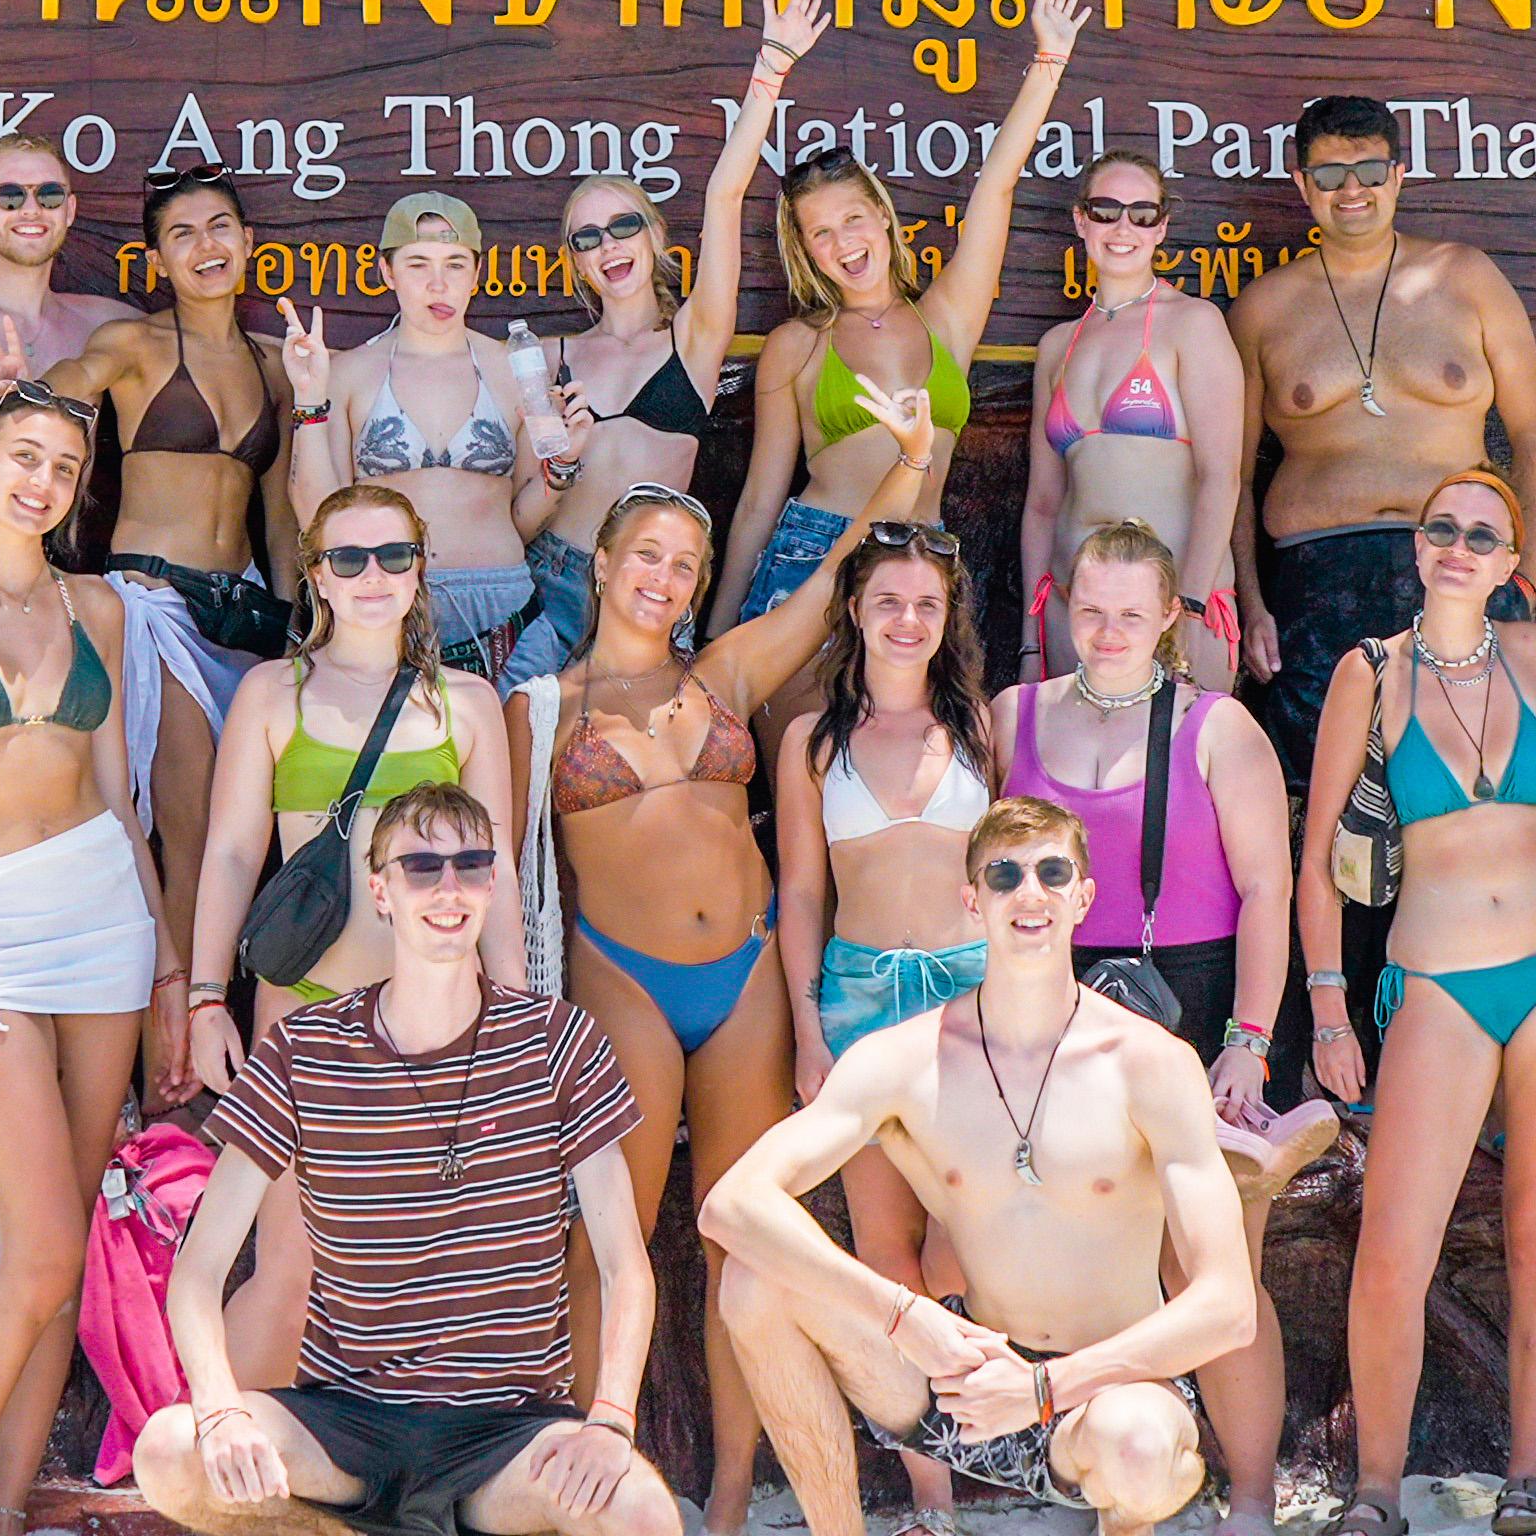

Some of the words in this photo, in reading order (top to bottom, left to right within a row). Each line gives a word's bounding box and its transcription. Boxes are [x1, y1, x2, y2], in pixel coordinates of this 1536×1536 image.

[148, 92, 345, 201] Ang
[384, 95, 682, 203] Thong
[1147, 98, 1323, 179] Par
[1129, 378, 1152, 394] 54
